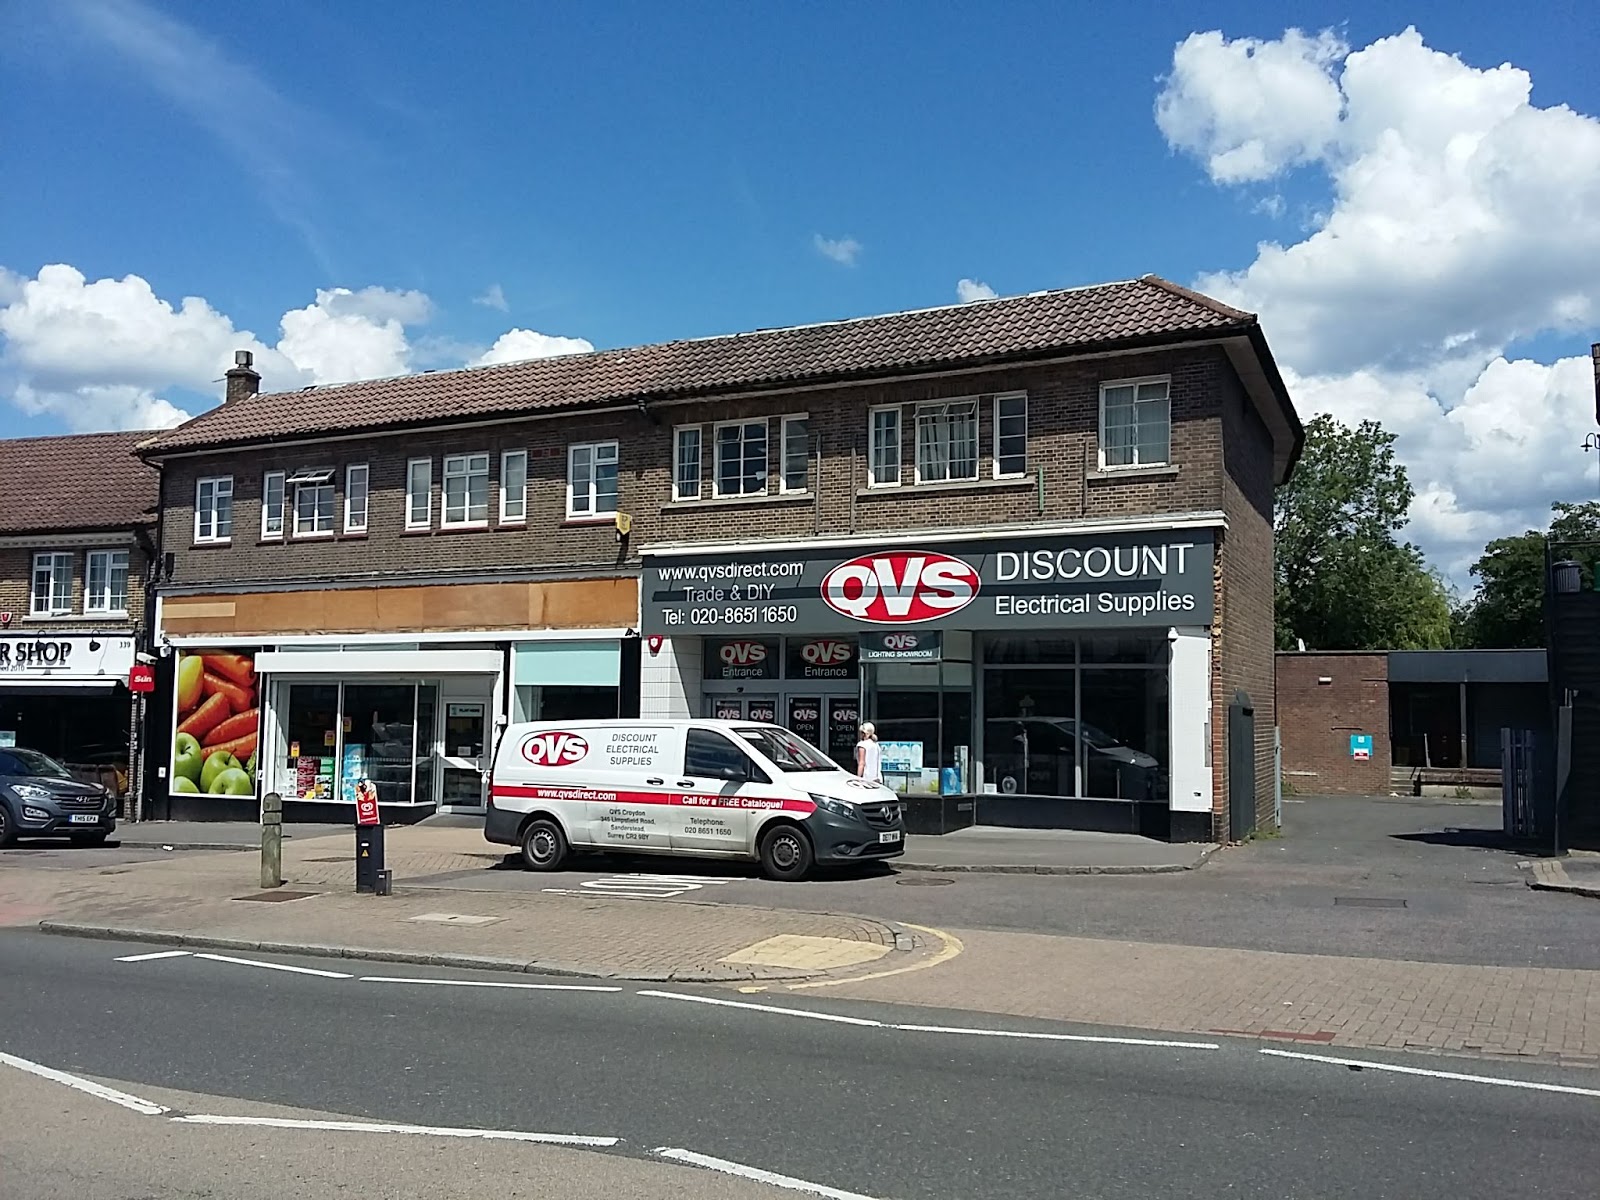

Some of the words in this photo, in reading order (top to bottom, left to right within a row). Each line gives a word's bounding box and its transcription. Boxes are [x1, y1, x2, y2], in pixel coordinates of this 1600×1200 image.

[996, 543, 1194, 581] DISCOUNT
[658, 561, 803, 583] www.qvsdirect.com
[683, 586, 724, 602] Trade
[730, 586, 741, 601] &
[747, 583, 776, 600] DIY
[827, 557, 973, 617] QVS
[995, 593, 1090, 615] Electrical
[1097, 591, 1195, 616] Supplies
[662, 608, 685, 625] Tel:
[690, 607, 758, 624] 020-8651
[761, 605, 797, 623] 1650
[884, 634, 918, 649] QVS
[15, 641, 72, 662] SHOP
[720, 641, 766, 663] QVS
[801, 641, 851, 663] QVS
[868, 650, 896, 658] LIGHTING
[896, 650, 933, 658] SHOWROOM
[722, 666, 763, 677] Entrance
[804, 666, 848, 677] Entrance
[717, 709, 741, 720] QVS
[750, 709, 774, 720] QVS
[793, 709, 818, 721] QVS
[833, 709, 858, 721] QVS
[796, 723, 814, 731] OPEN
[836, 724, 855, 732] OPEN
[611, 733, 657, 742] DISCOUNT
[523, 735, 587, 764] QVS
[606, 745, 659, 754] ELECTRICAL
[609, 757, 652, 766] SUPPLIES
[537, 788, 616, 801] www.qvsdirect.com
[682, 795, 698, 805] Call
[698, 796, 710, 805] for
[718, 798, 740, 807] FREE
[741, 799, 784, 810] Catalogue!
[690, 817, 725, 826] Telephone:
[684, 826, 696, 834] 020
[698, 827, 713, 835] 8651
[716, 828, 731, 836] 1650
